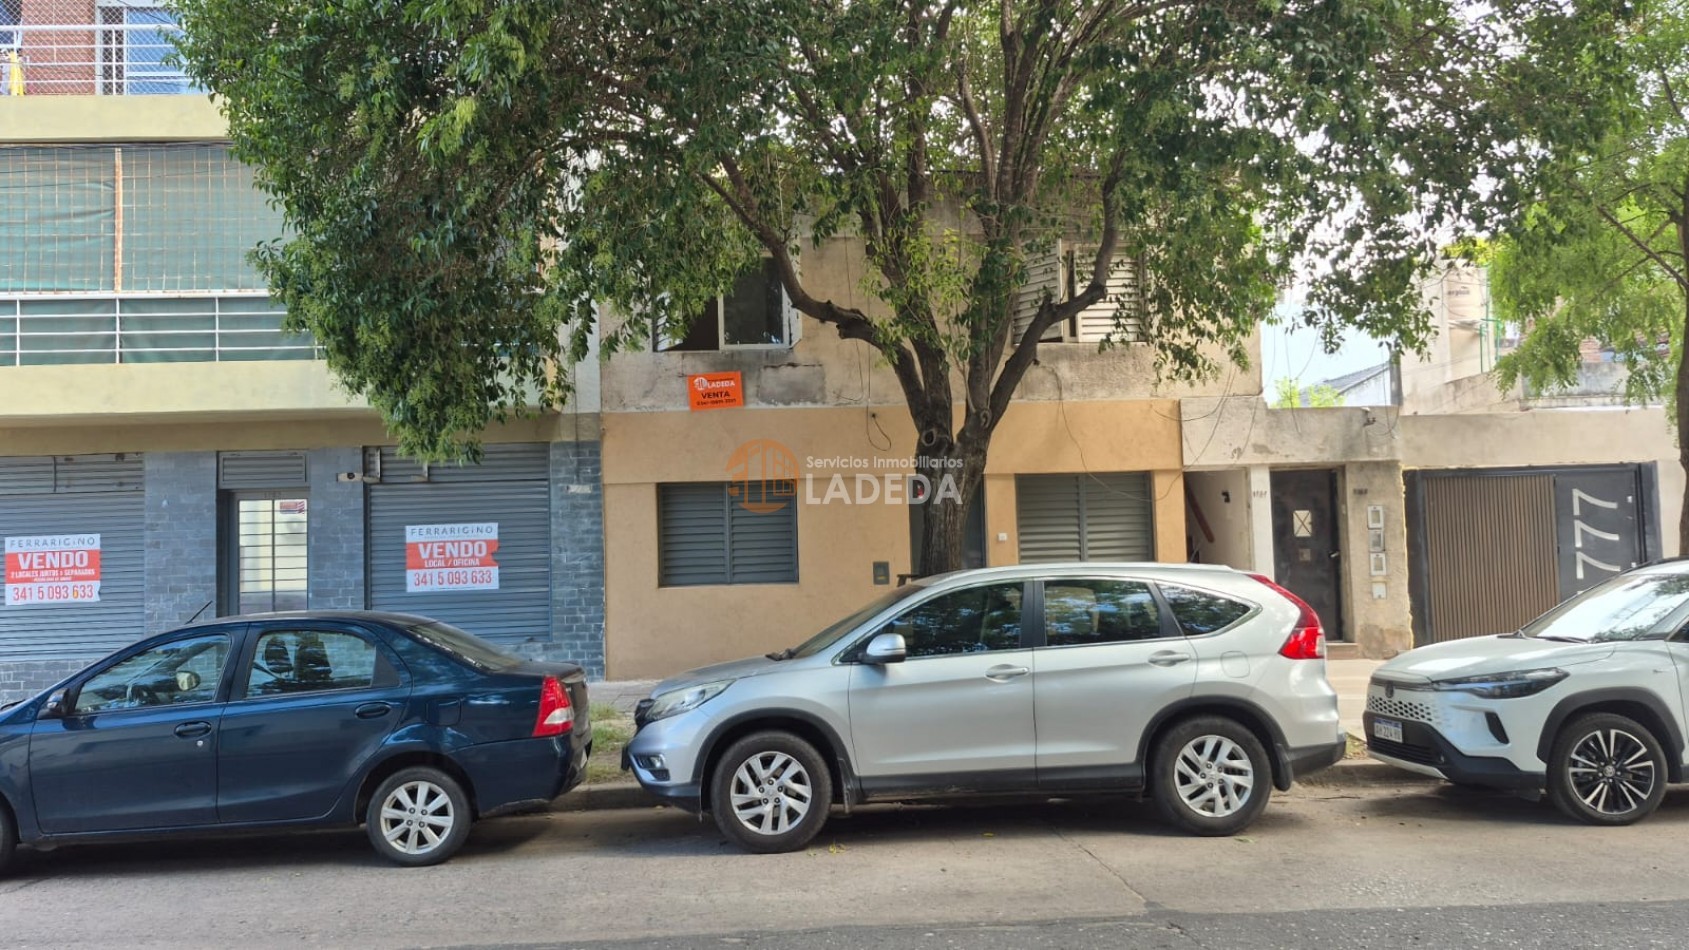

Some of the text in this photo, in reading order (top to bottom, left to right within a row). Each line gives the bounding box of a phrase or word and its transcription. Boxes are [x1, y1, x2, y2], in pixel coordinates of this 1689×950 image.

[701, 391, 730, 399] VENTA
[418, 541, 487, 559] VENDO
[17, 551, 89, 570] VENDO
[424, 559, 445, 568] LOCAL
[453, 558, 480, 567] OFICINA
[414, 570, 492, 587] 341 5 093 633
[13, 584, 93, 601] 341 5 093 633
